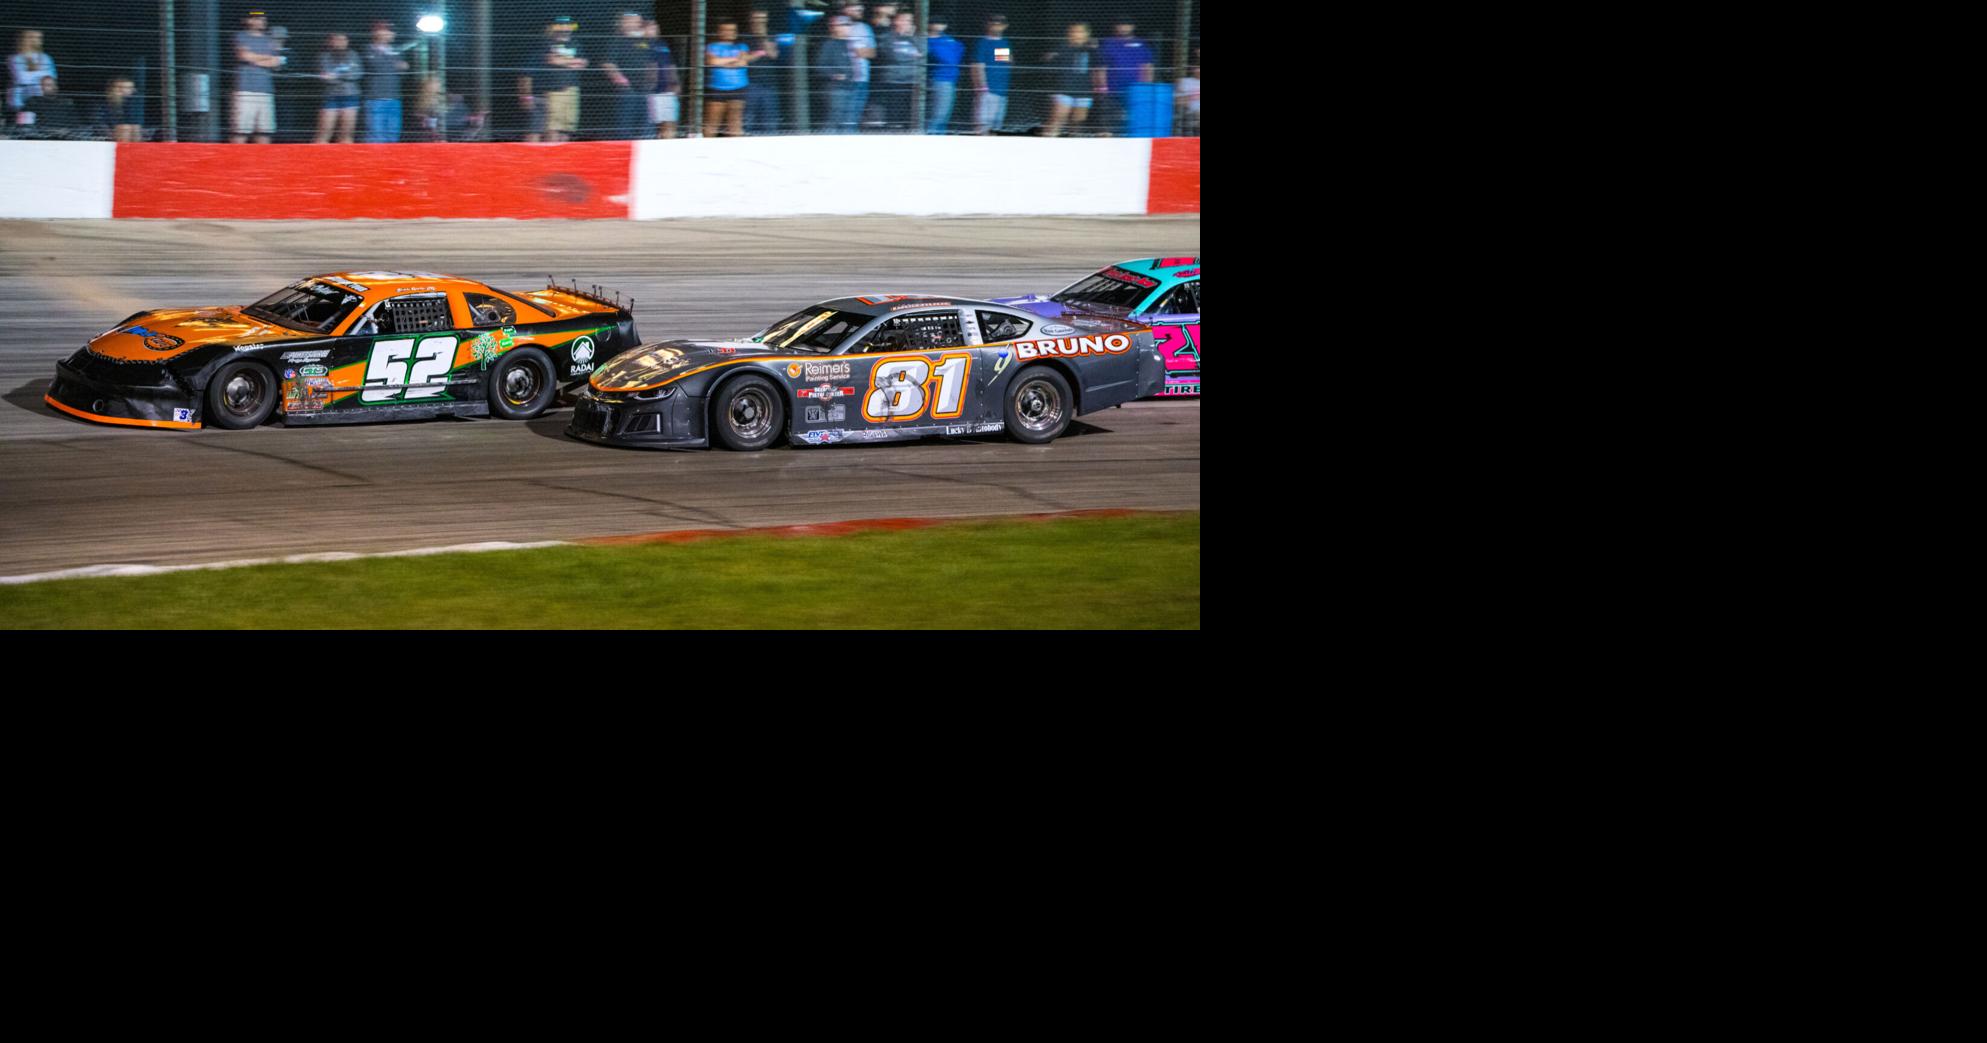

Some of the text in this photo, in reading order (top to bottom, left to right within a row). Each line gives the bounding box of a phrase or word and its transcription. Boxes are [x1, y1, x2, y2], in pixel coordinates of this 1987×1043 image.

[361, 335, 458, 402] 52
[1016, 334, 1130, 359] BRUNO
[1152, 325, 1200, 371] 2
[865, 355, 969, 420] 81
[179, 410, 189, 420] 3
